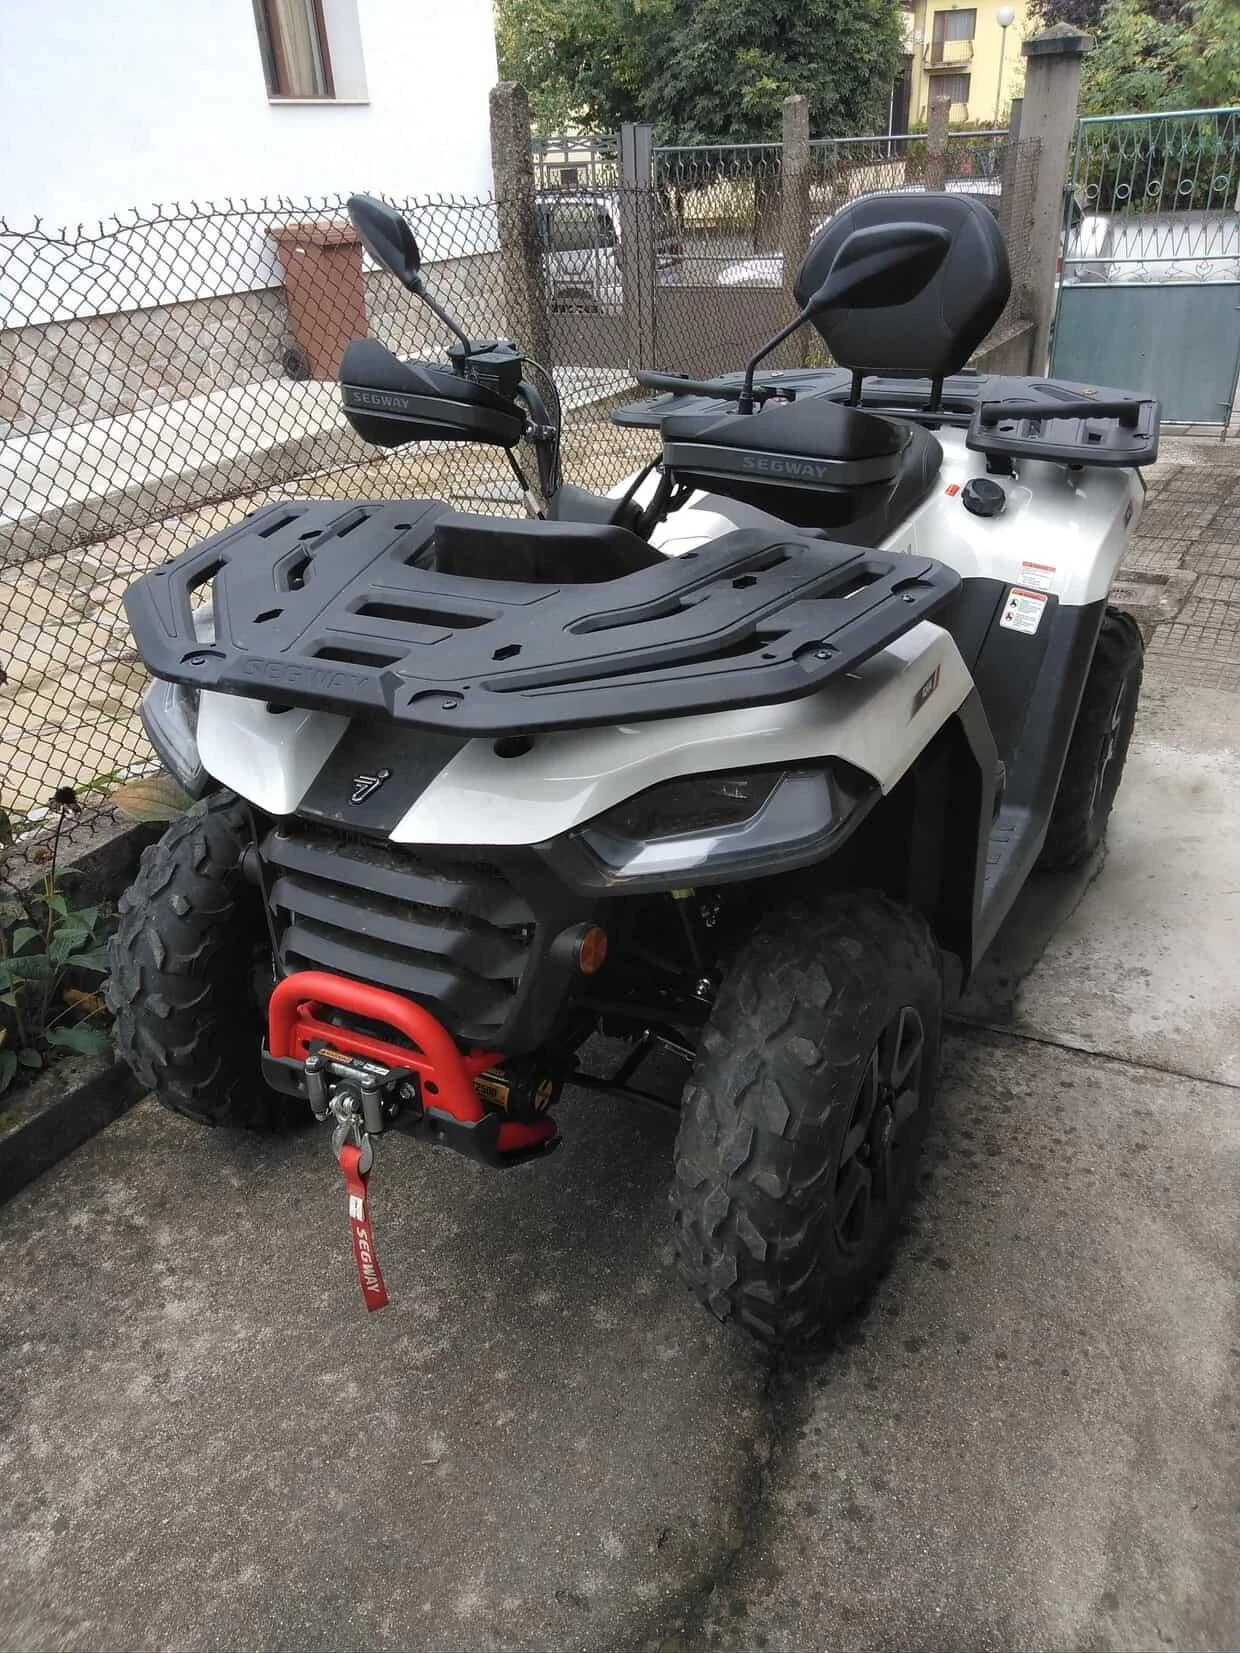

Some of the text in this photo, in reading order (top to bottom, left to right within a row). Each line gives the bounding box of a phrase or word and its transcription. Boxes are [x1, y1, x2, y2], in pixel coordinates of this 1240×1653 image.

[352, 391, 409, 409] SEGWAY
[742, 456, 828, 478] SEGWAY
[243, 658, 369, 689] SEGWAY
[356, 1226, 381, 1293] SEGWAY
